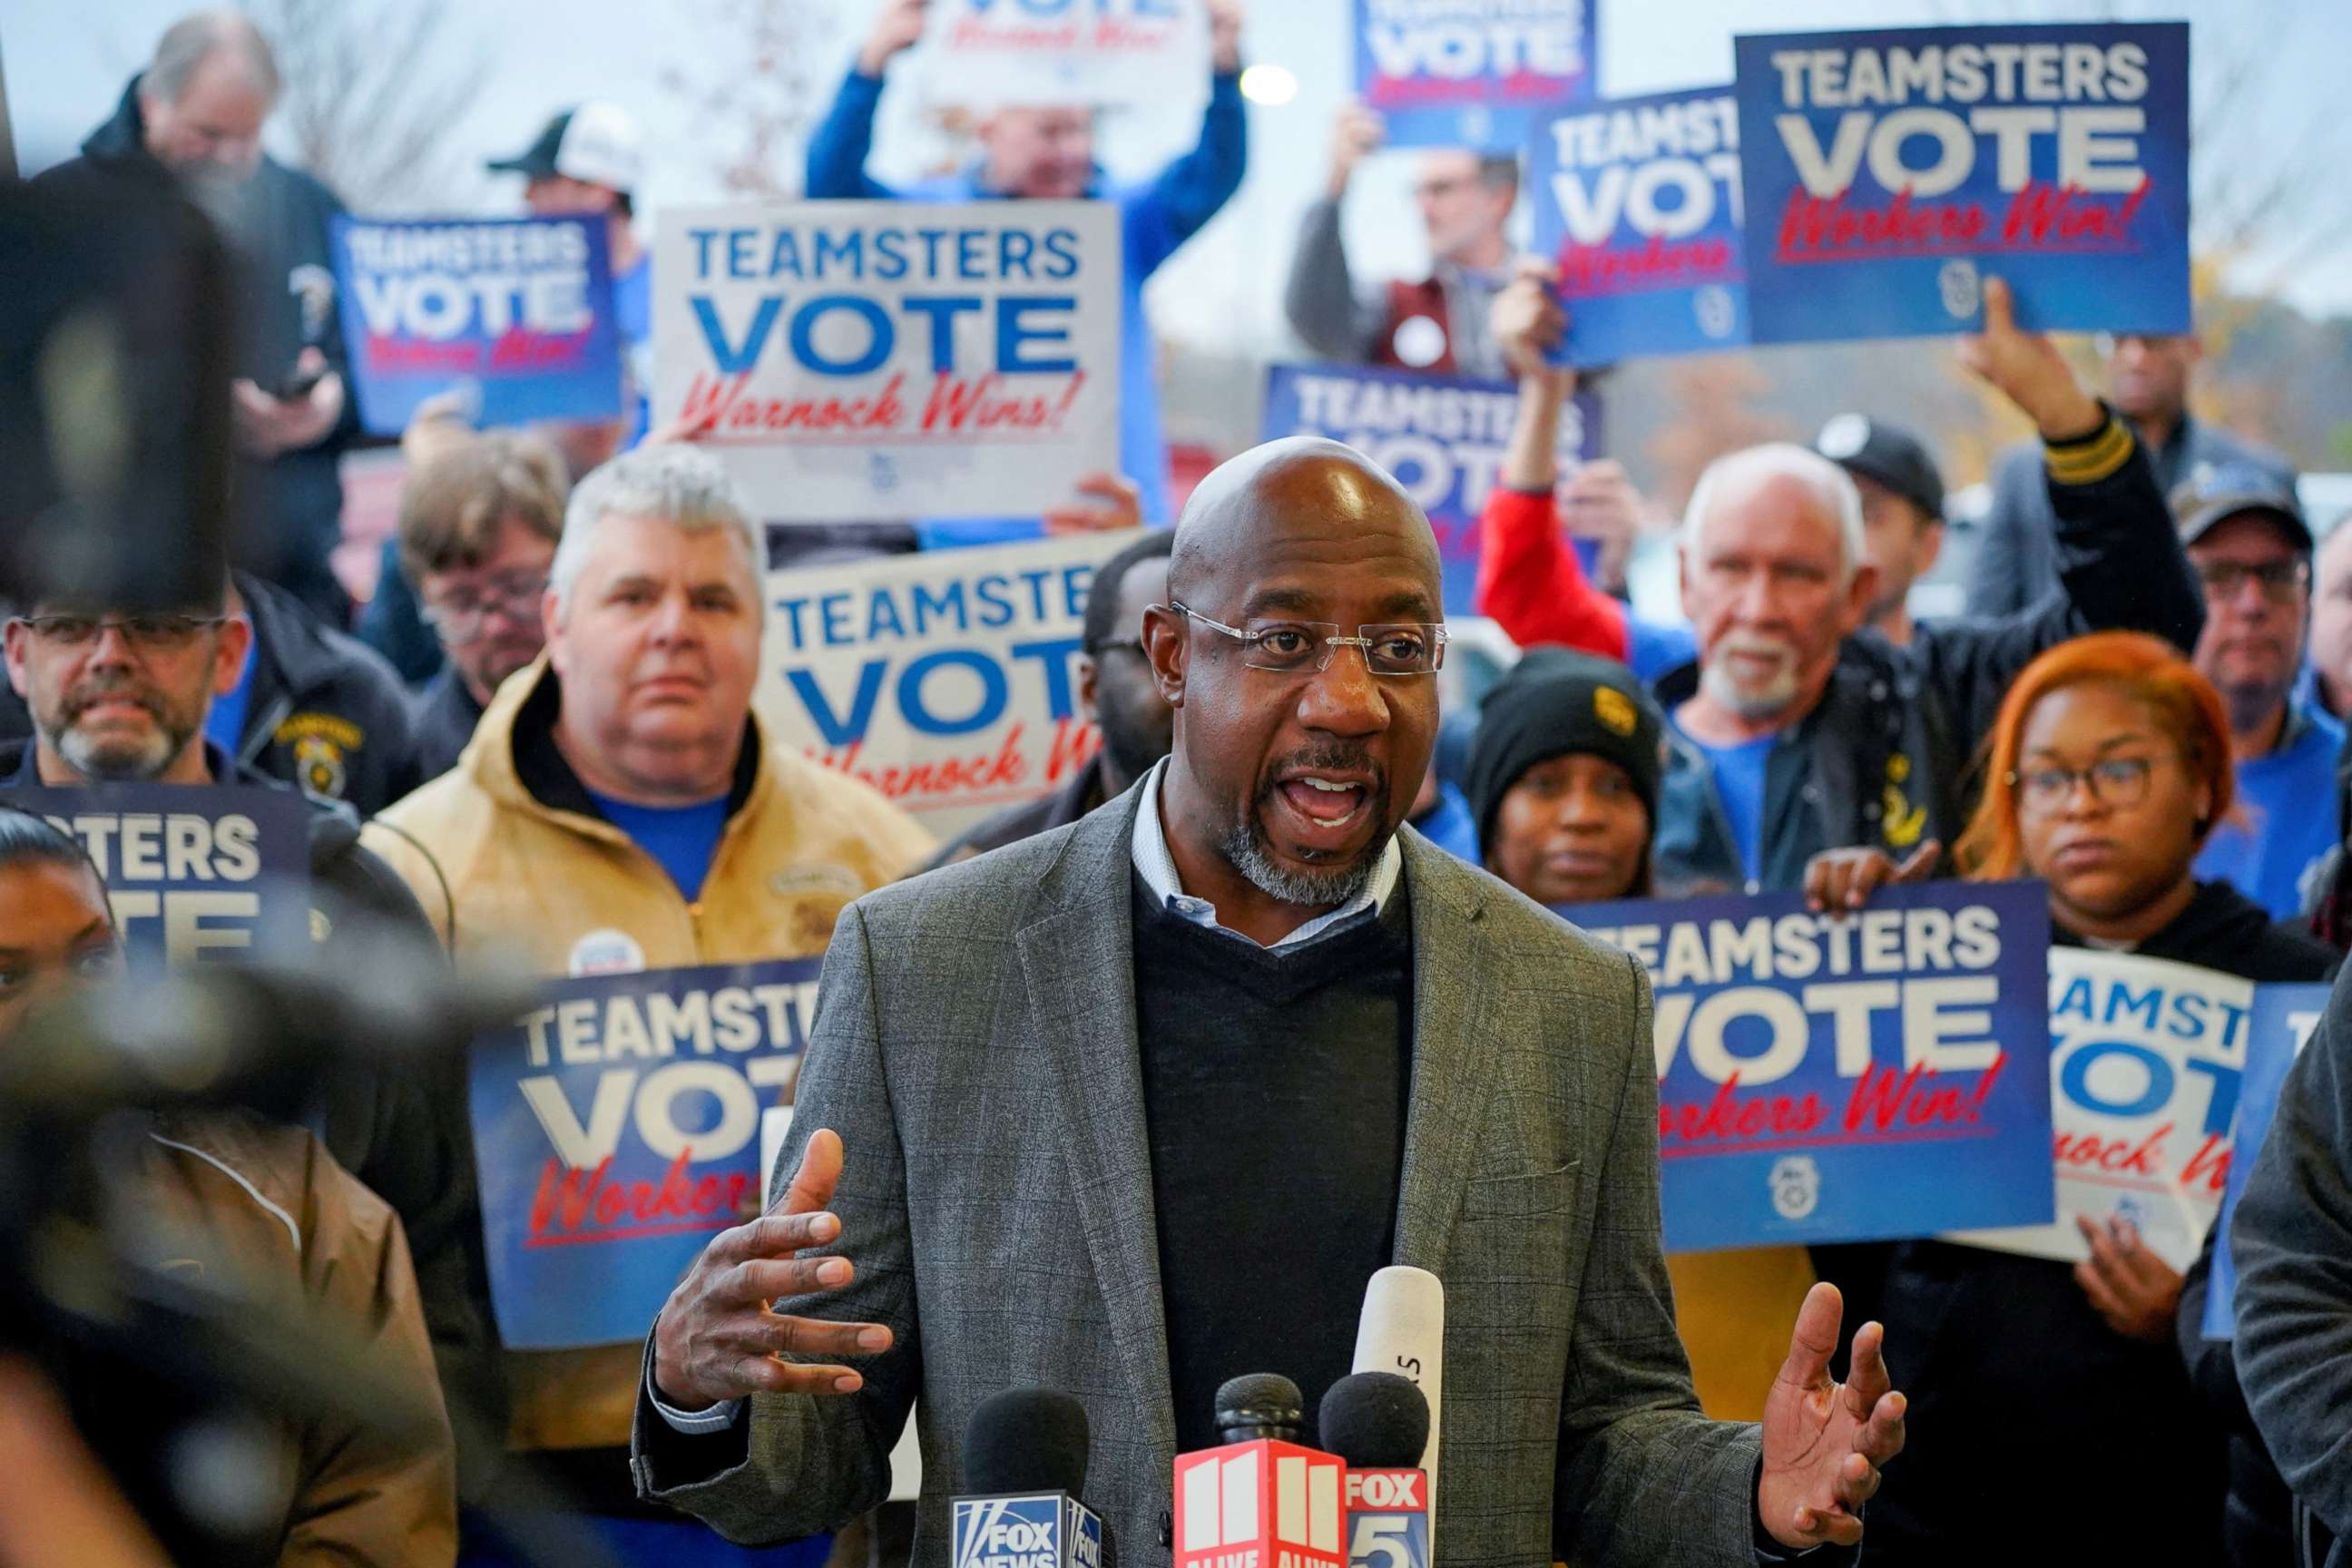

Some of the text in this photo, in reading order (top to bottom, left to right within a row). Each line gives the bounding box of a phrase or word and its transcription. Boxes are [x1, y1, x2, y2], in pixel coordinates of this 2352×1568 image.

[1771, 41, 2149, 109] TEAMSTERS
[1776, 105, 2147, 199] VOTE
[1779, 172, 2155, 250] Workers Win!
[687, 225, 1082, 279] TEAMSTERS
[356, 270, 592, 339] VOTE
[689, 293, 1077, 378] VOTE
[679, 365, 1087, 436] Warnock Wins!
[1294, 372, 1585, 450] TEAMSTES
[1590, 904, 2002, 987] EAMSTERS
[2049, 976, 2252, 1049] AMST
[1658, 1051, 2010, 1142] orkers Win!
[2051, 1034, 2245, 1140] OT
[527, 1143, 762, 1234] Worker
[1345, 1473, 1419, 1507] FOX
[988, 1521, 1055, 1554] FOX
[1350, 1515, 1409, 1568] 5
